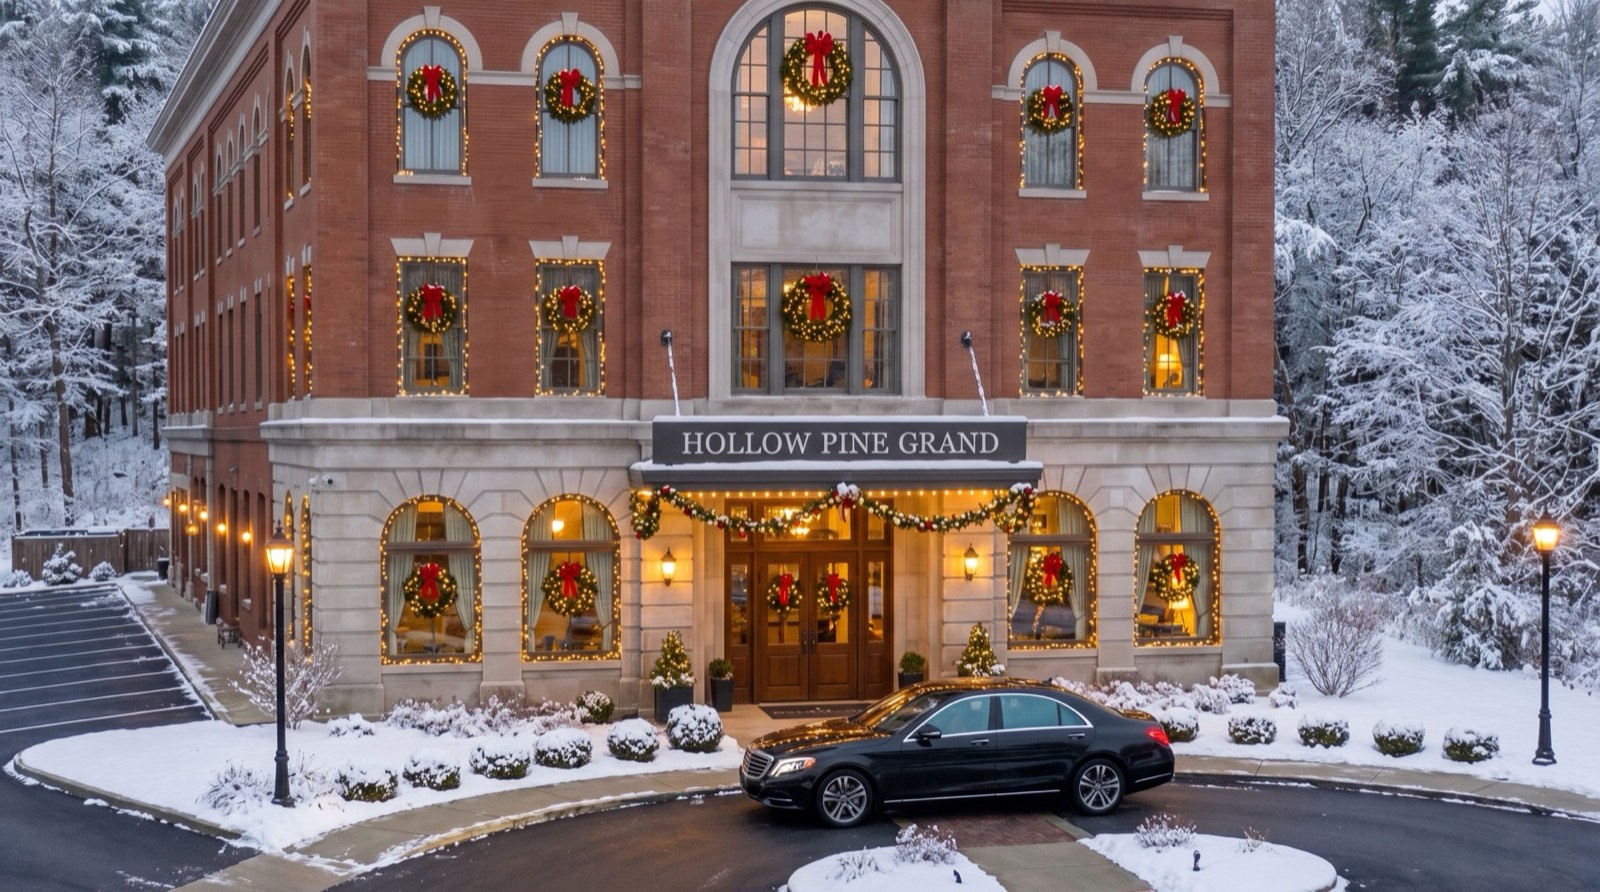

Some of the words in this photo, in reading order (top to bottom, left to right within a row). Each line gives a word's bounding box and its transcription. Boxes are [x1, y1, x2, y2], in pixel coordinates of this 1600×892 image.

[682, 432, 811, 454] HOLLOW
[821, 432, 889, 454] PINE
[898, 432, 999, 454] GRAND
